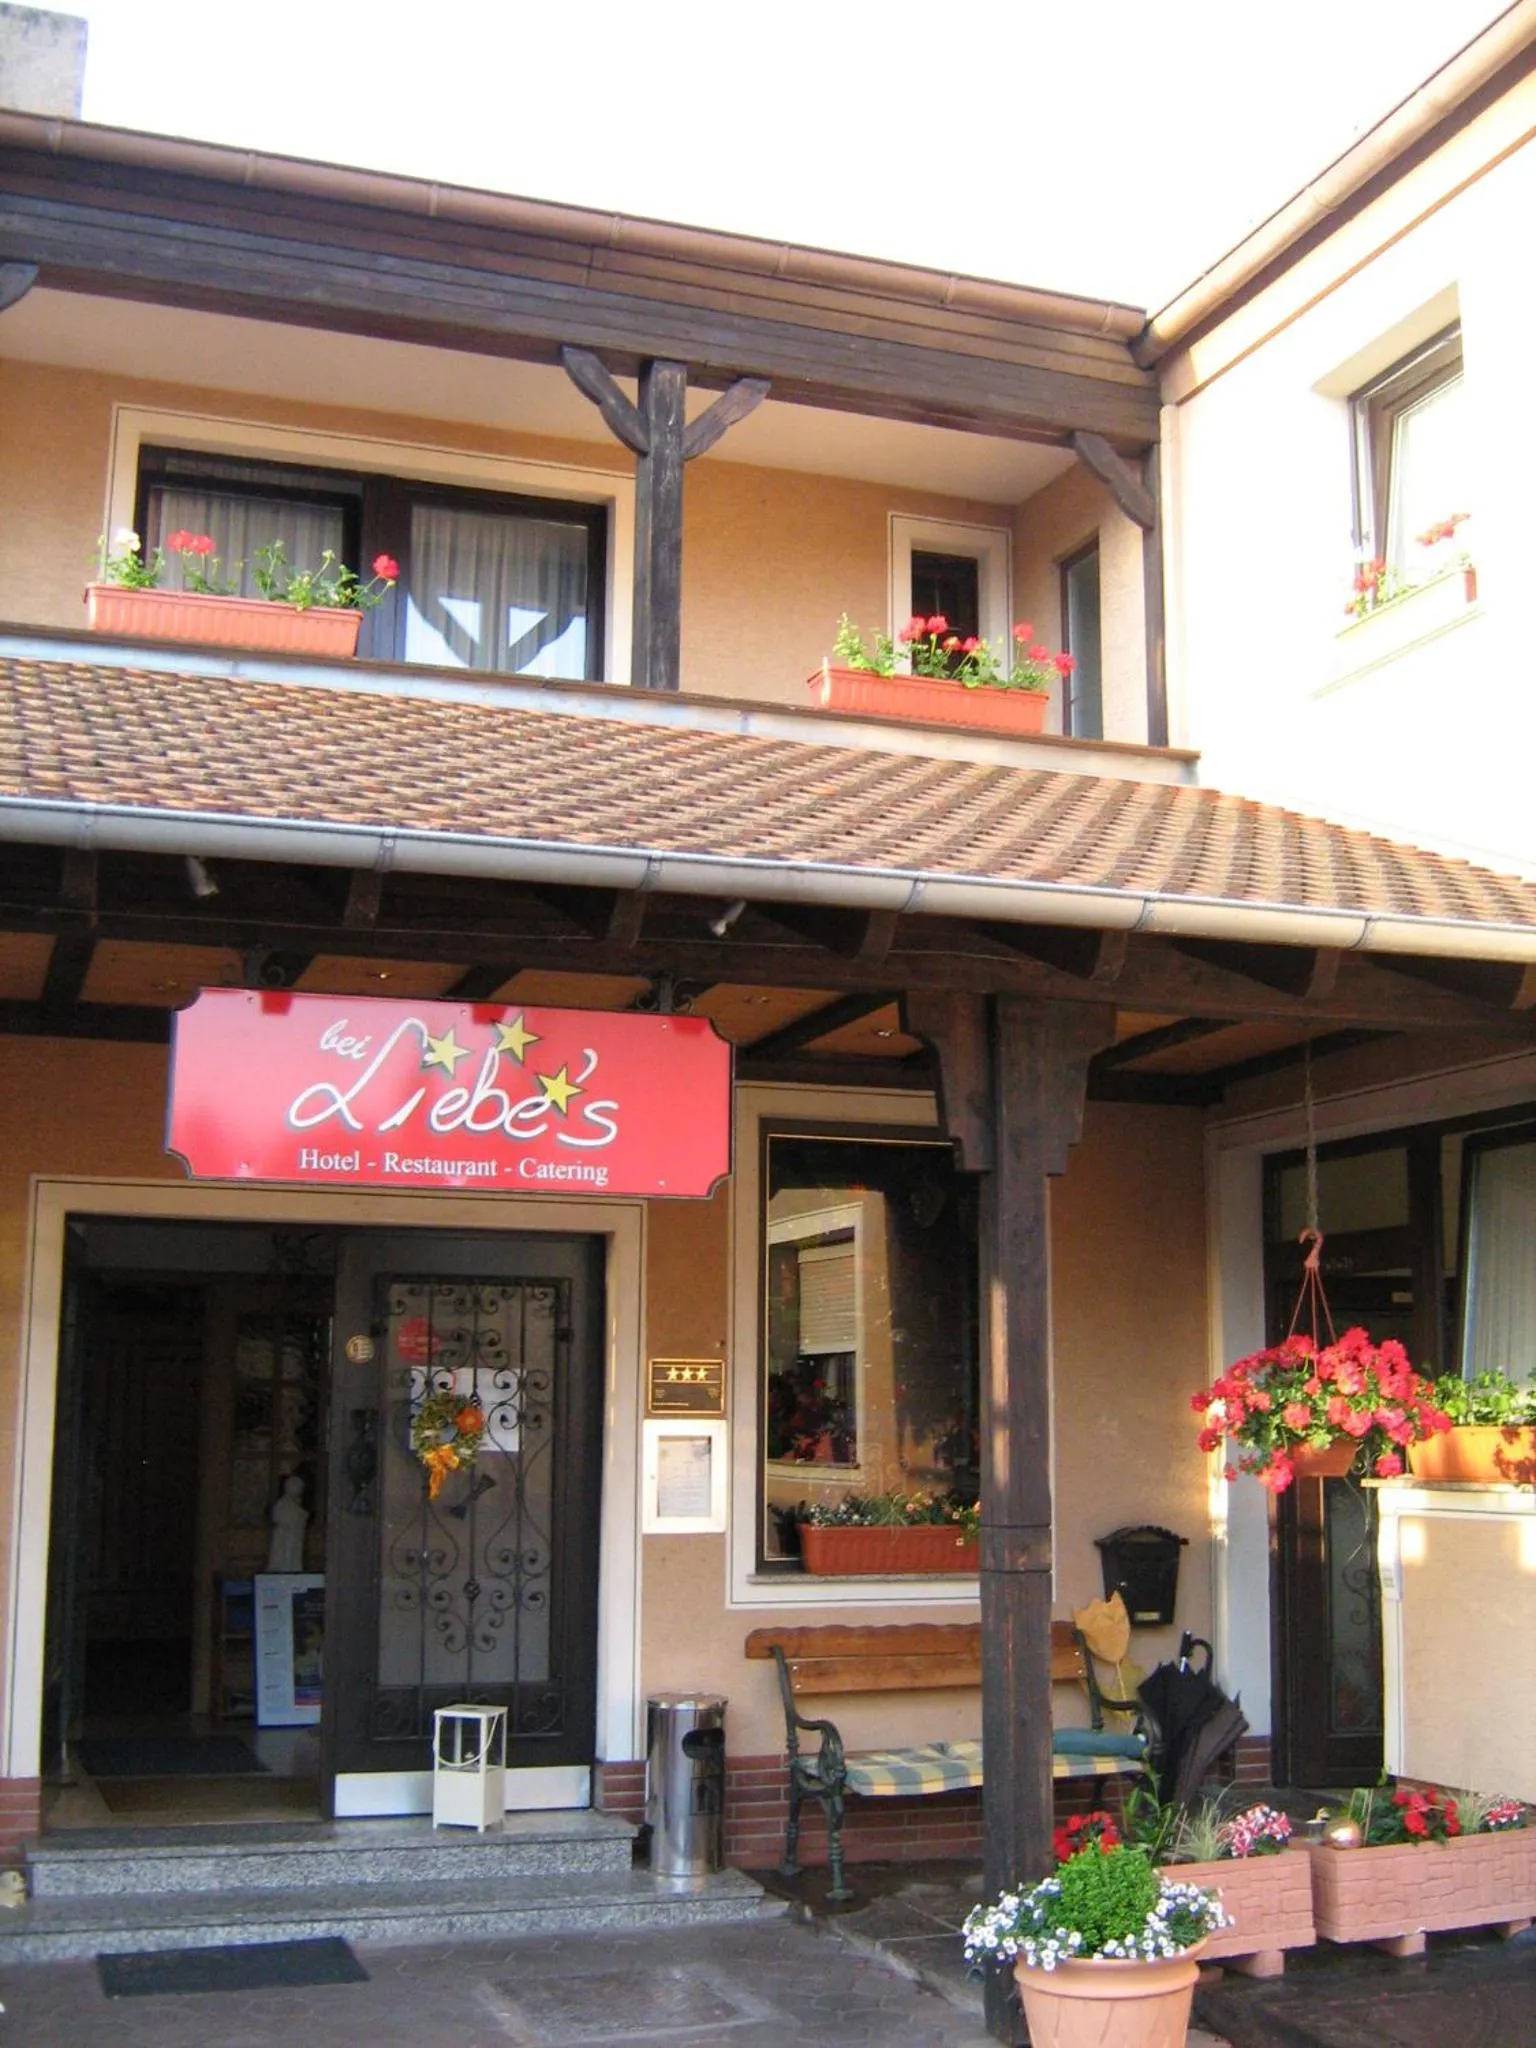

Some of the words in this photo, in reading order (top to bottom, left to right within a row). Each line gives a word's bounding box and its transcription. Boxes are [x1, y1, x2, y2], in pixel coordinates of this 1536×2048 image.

[319, 1018, 371, 1060] bei
[289, 1017, 619, 1147] Liebe's
[300, 1148, 361, 1171] Hotel
[384, 1151, 499, 1177] Restaurant
[519, 1157, 609, 1187] Catering
